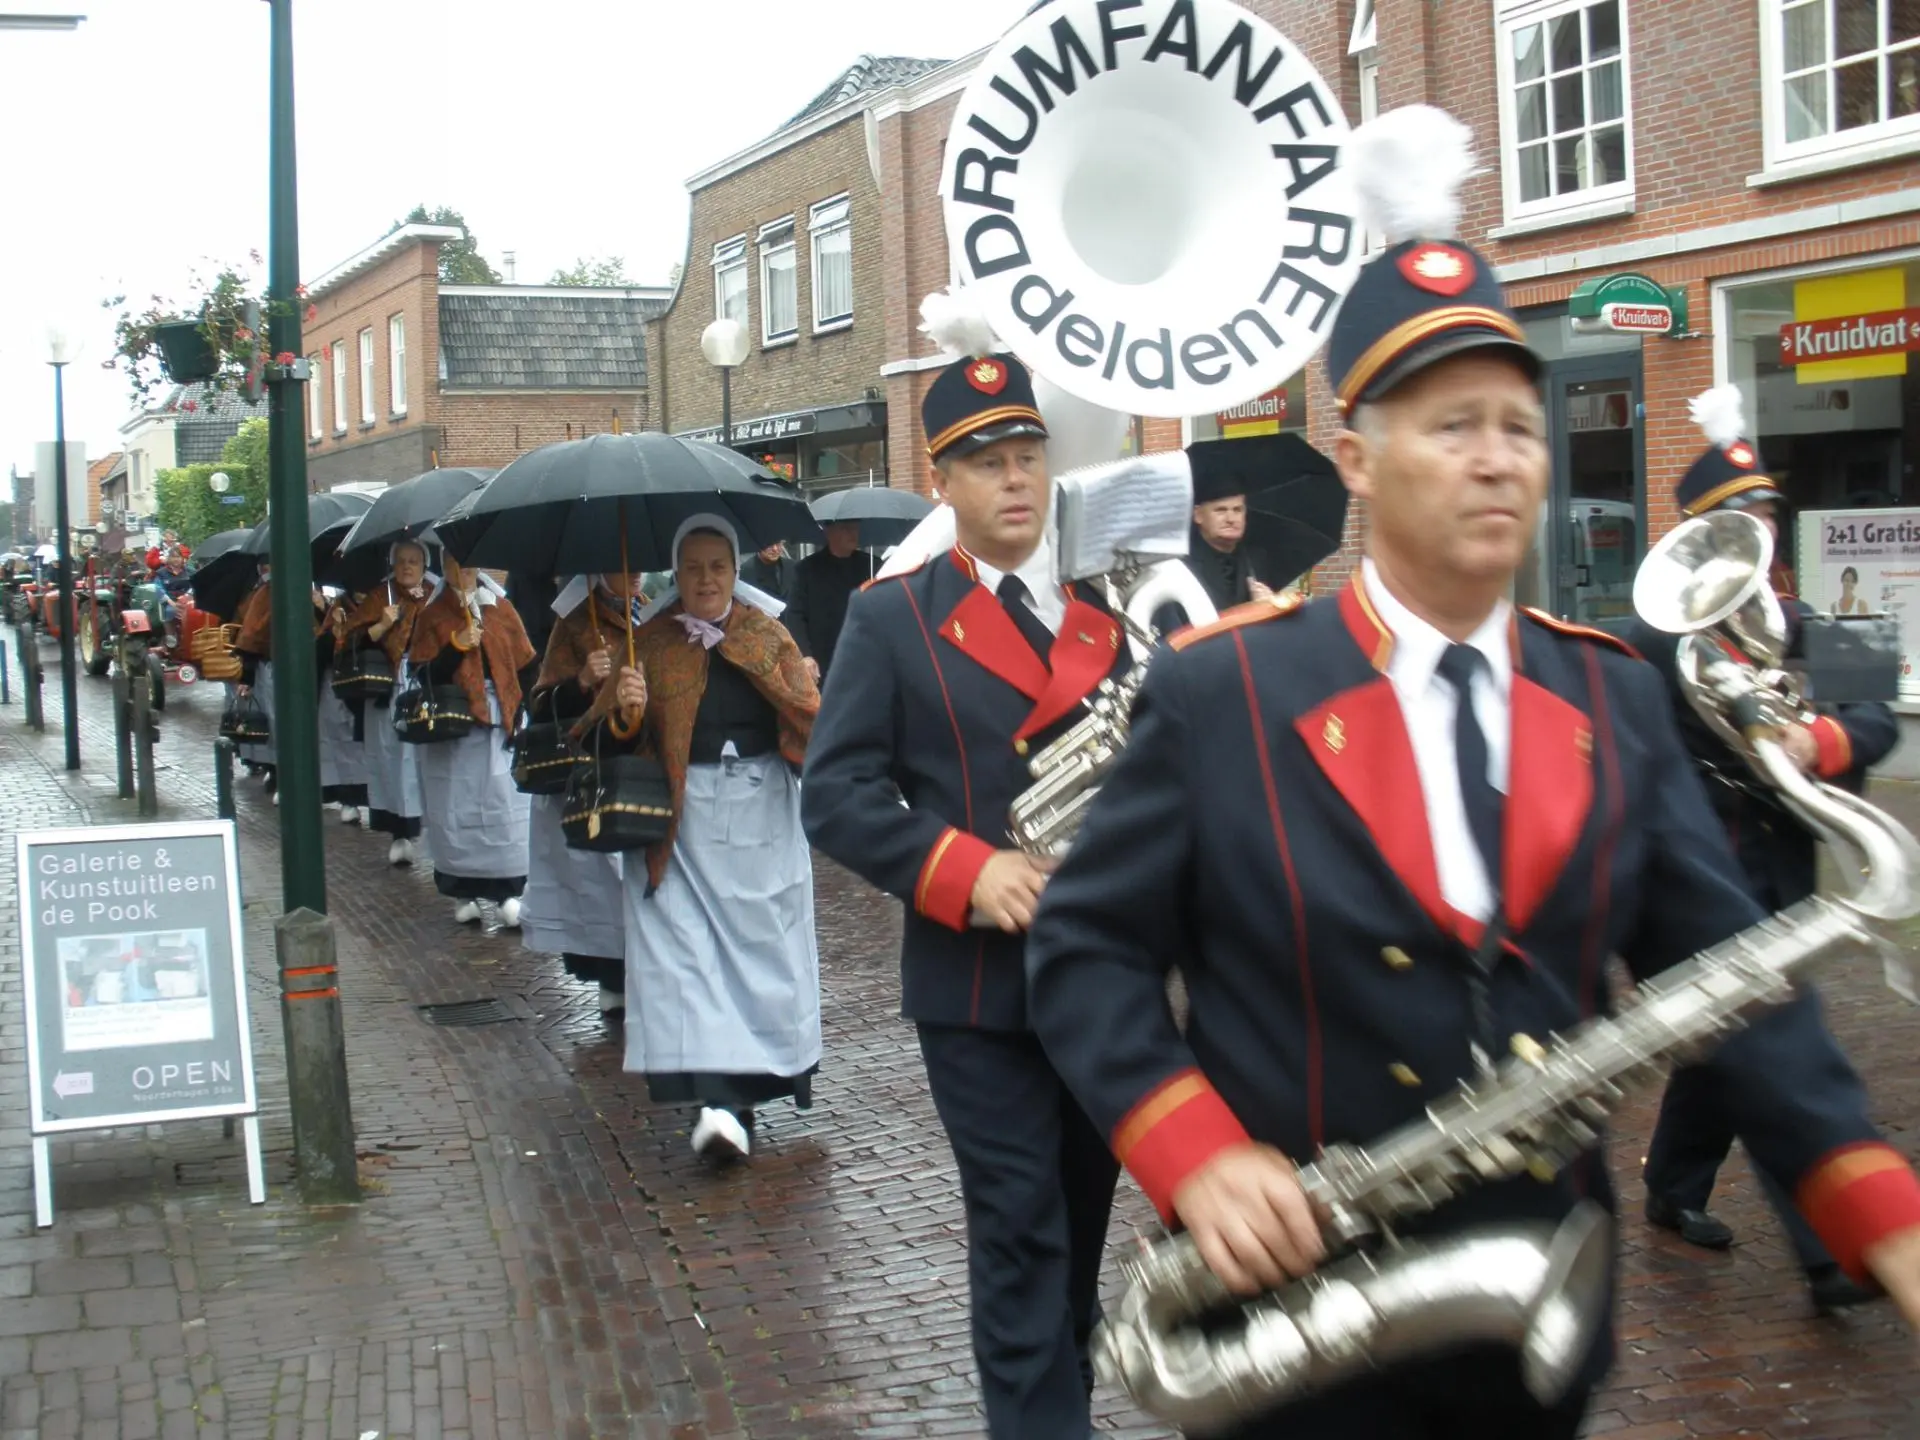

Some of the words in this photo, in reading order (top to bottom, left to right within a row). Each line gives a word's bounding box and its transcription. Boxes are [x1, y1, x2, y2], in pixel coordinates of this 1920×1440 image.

[953, 0, 1354, 333] DRUMFANFARE
[1618, 308, 1663, 325] Kruidvat
[1010, 274, 1285, 391] delden
[1795, 317, 1907, 357] Kruidvat
[1827, 524, 1857, 544] 2+1
[1863, 520, 1920, 543] Gratis
[39, 850, 142, 875] Galerie
[154, 848, 172, 868] &
[40, 874, 216, 900] Kunstuitleen
[41, 905, 75, 925] de
[88, 900, 158, 923] Pook
[132, 1059, 231, 1090] OPEN
